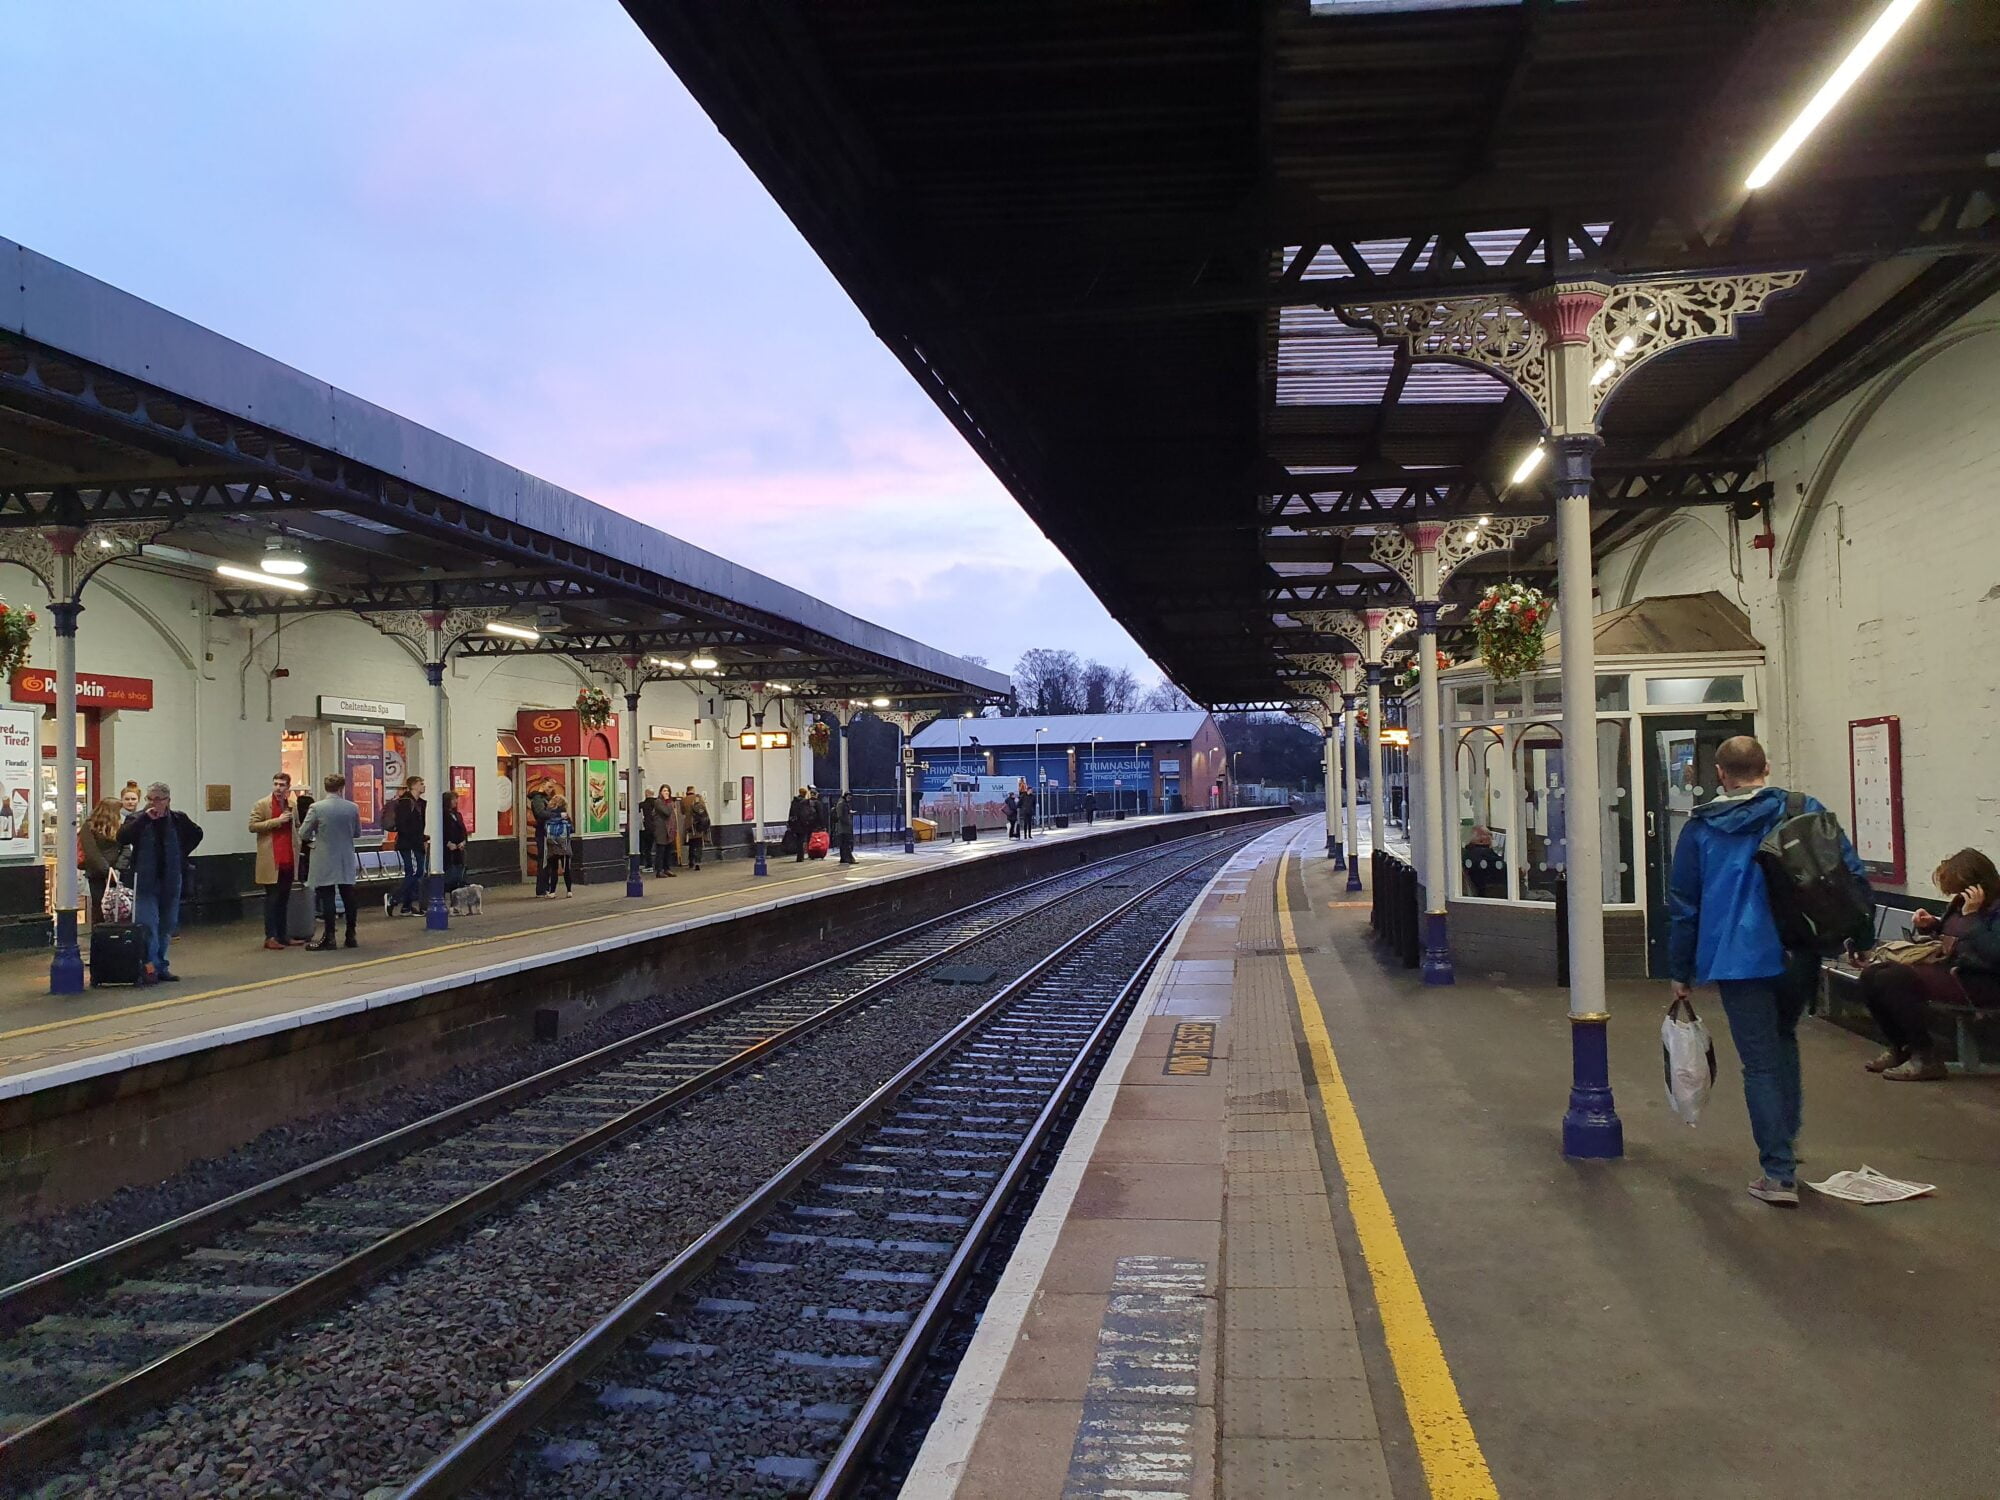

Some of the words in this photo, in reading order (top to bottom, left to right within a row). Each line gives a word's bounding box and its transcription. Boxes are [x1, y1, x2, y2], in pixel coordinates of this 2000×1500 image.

[45, 677, 104, 697] Ppkin
[128, 691, 147, 701] shop
[340, 701, 377, 712] Cheltenham
[378, 705, 389, 714] Spa
[707, 698, 714, 715] 1
[4, 735, 30, 746] Tired?
[533, 733, 561, 744] café
[534, 745, 562, 754] shop
[1084, 761, 1150, 771] TRIMNASIUM
